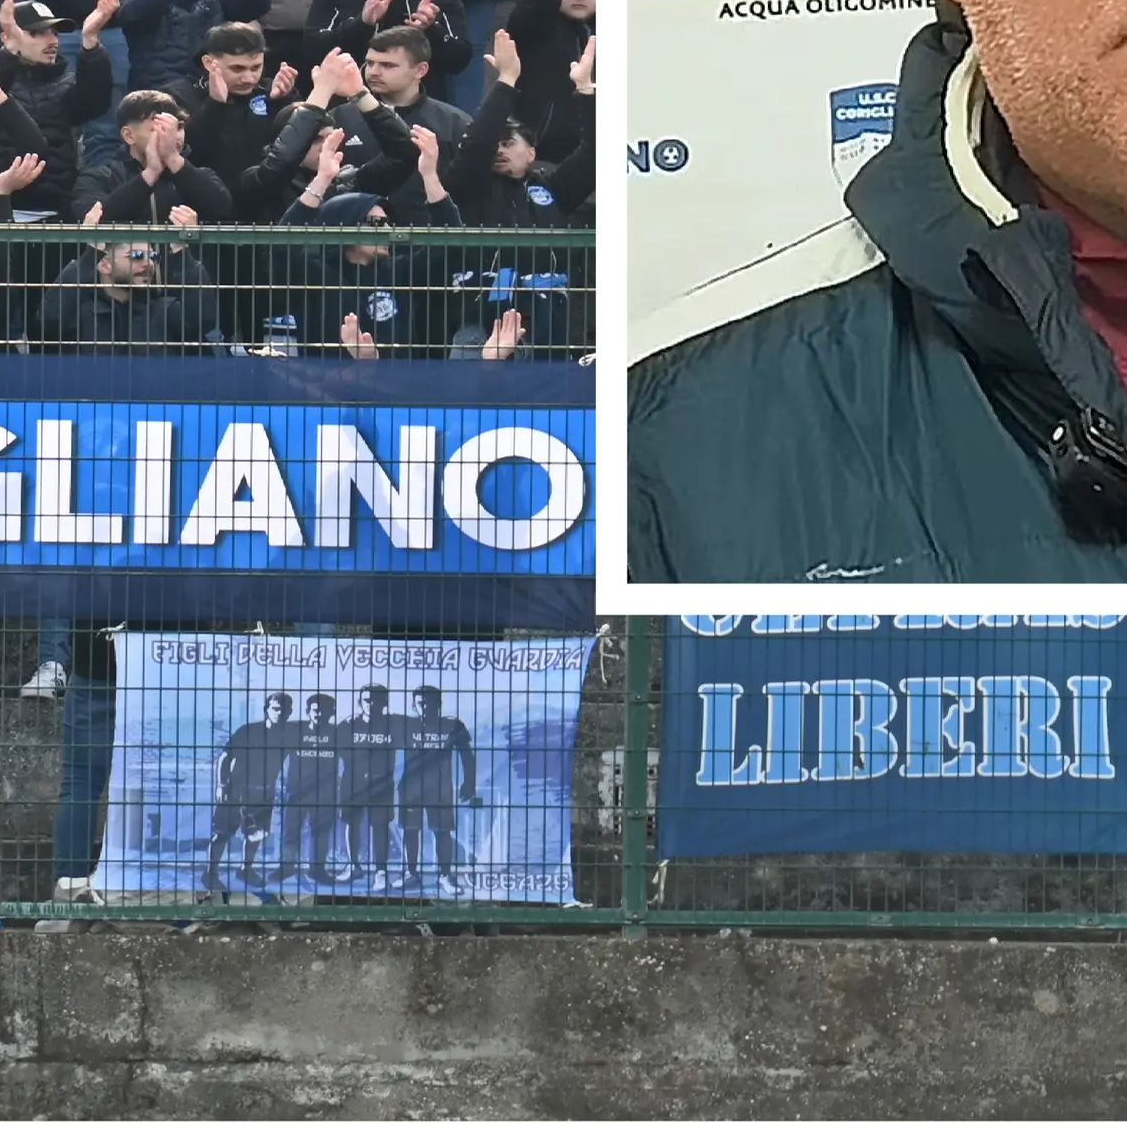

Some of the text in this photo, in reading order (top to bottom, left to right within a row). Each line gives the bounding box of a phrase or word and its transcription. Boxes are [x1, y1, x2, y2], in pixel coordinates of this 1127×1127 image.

[719, 0, 800, 20] ACQUA
[152, 640, 585, 672] FIGLI DELLA VECCHIA GUARDIA
[696, 675, 1116, 786] LIBERI
